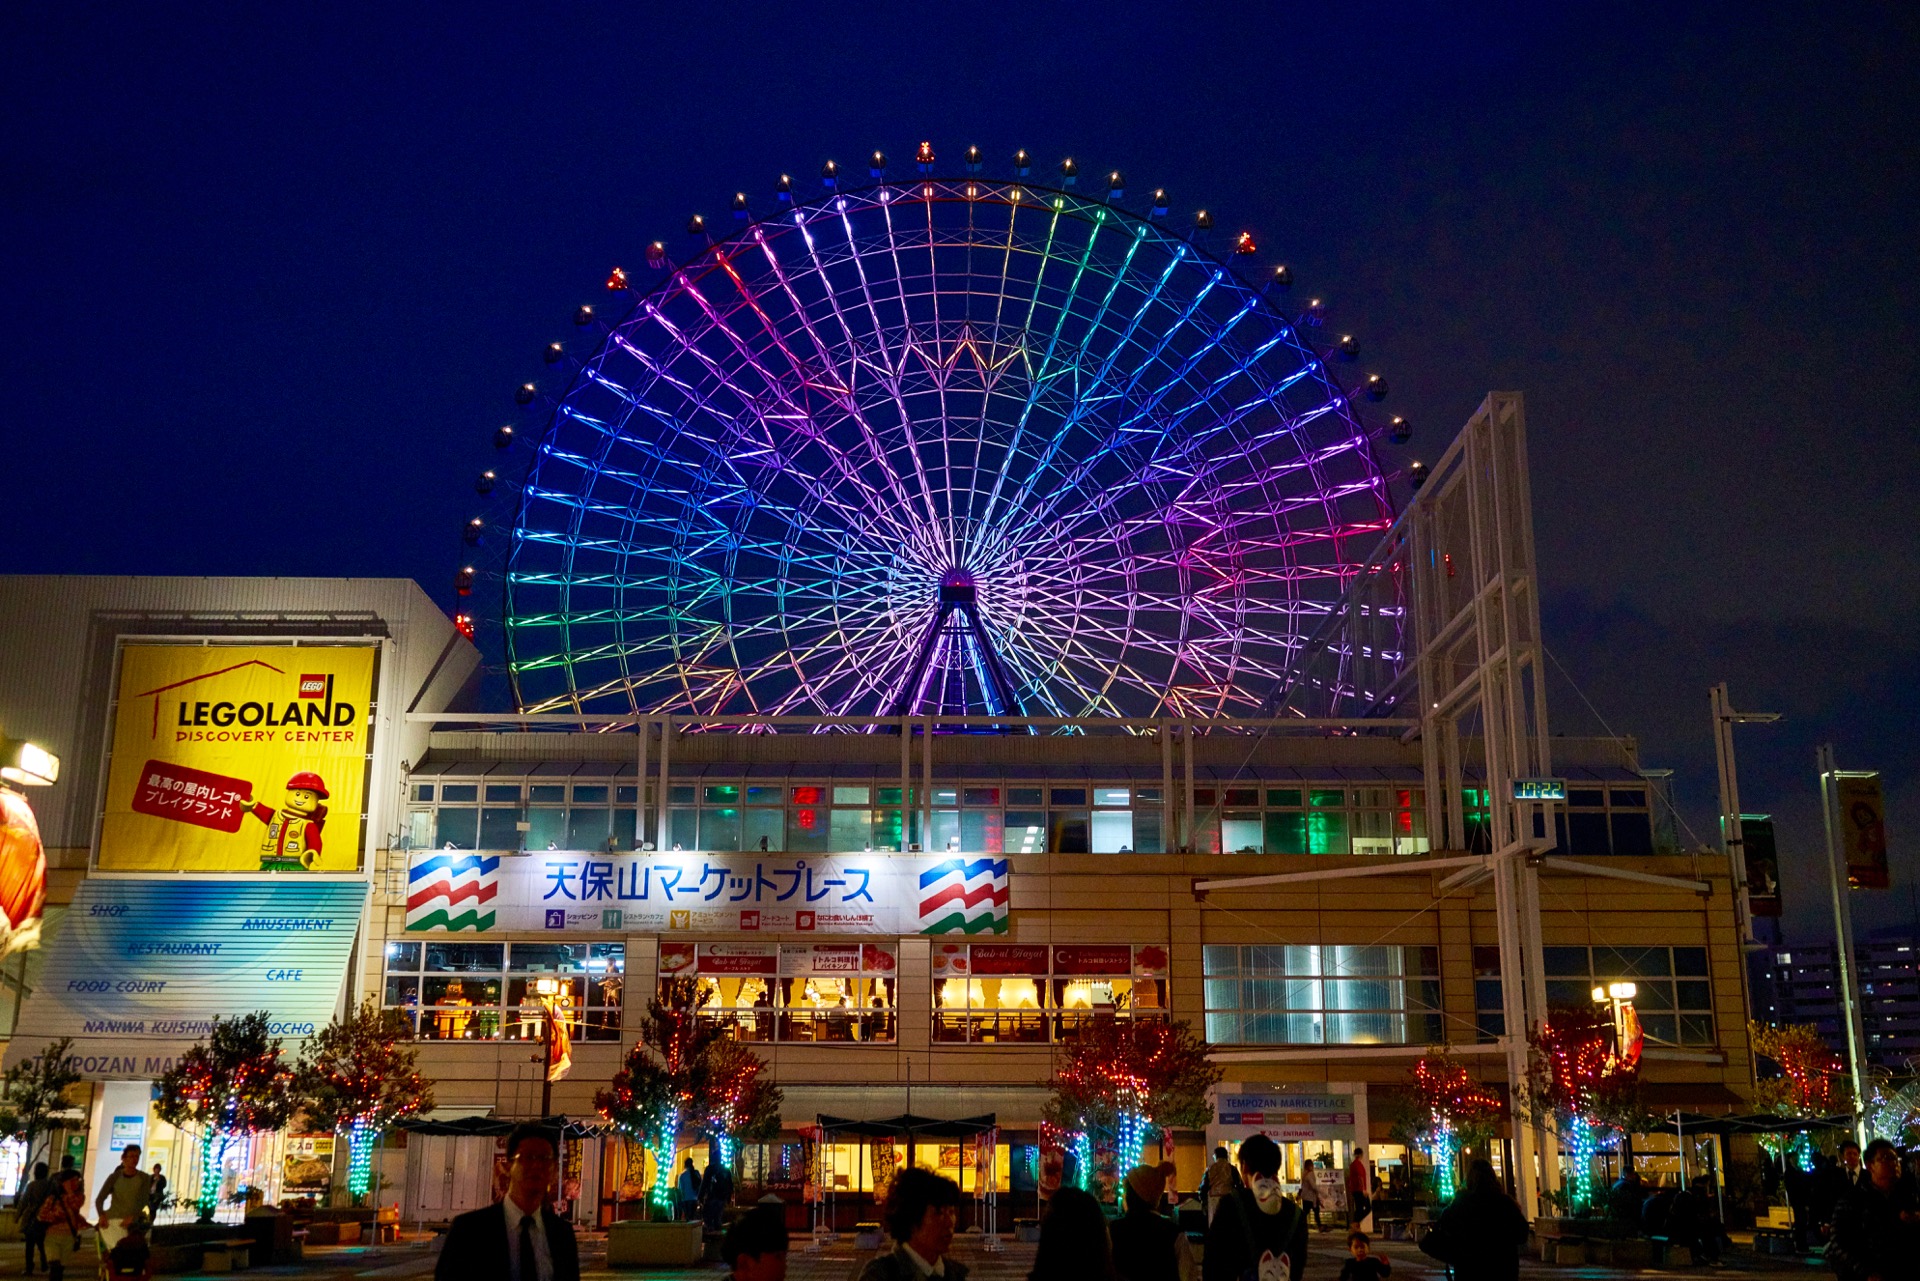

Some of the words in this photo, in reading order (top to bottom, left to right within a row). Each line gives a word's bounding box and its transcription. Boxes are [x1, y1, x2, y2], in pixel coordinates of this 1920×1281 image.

[301, 680, 325, 692] LEGO
[178, 674, 356, 727] LEGOLAND
[176, 731, 276, 742] DISCOVERY
[285, 731, 355, 742] CENTER
[1522, 782, 1562, 798] 17:22
[543, 860, 874, 903] 天保山マーケットプレース
[89, 904, 130, 917] SHOP
[241, 918, 334, 931] AMUSEMENT
[126, 943, 223, 956] RESTAURANT
[265, 969, 303, 982] CAFE
[67, 981, 111, 993] FOOD
[115, 981, 167, 993] COURT
[82, 1021, 145, 1034] NANIWA
[1226, 1099, 1277, 1109] TEMPOZAN
[1281, 1099, 1346, 1109] MARKETPLACE
[1283, 1130, 1315, 1138] ENTRANCE
[296, 1142, 313, 1150] 入口
